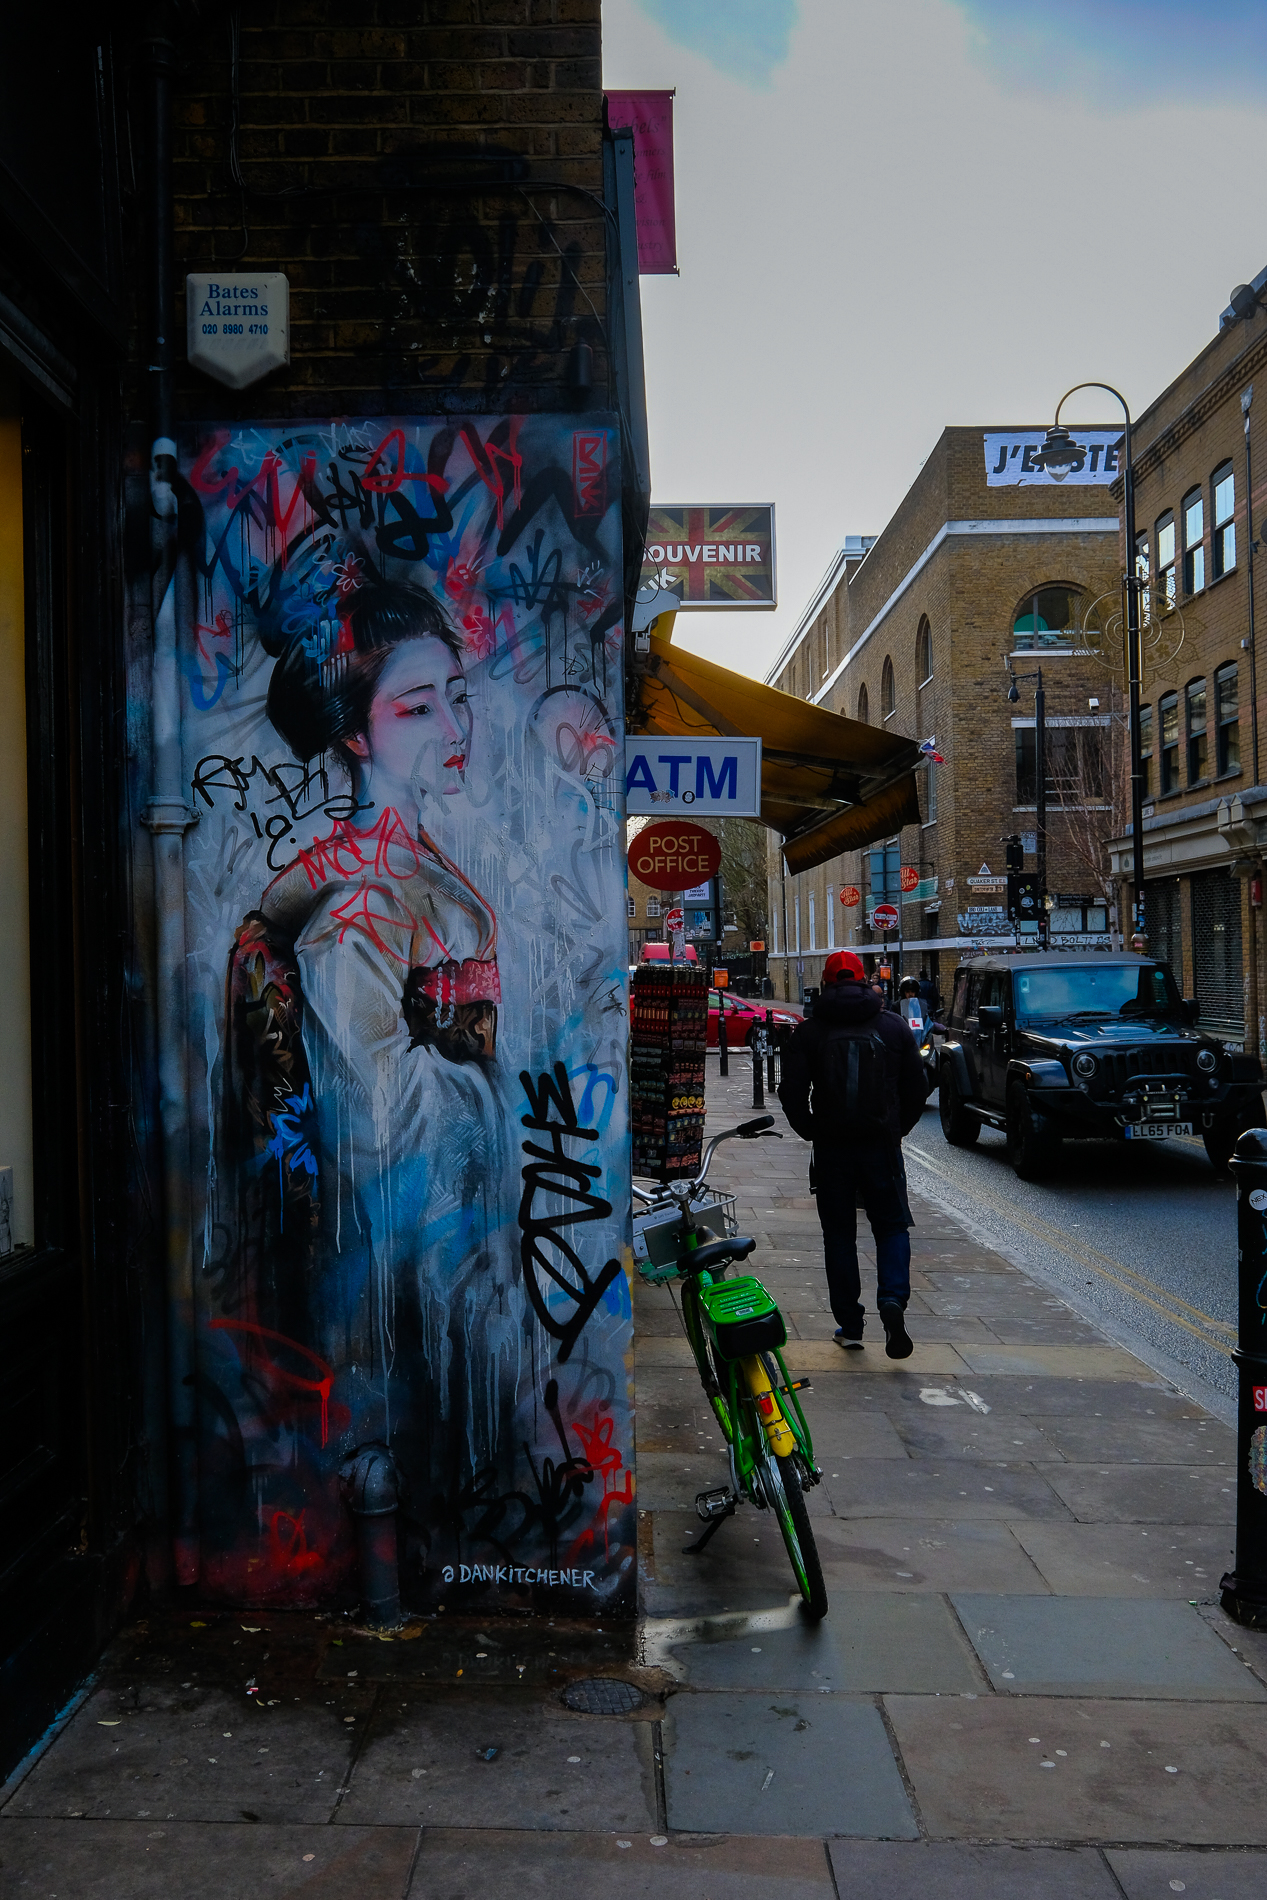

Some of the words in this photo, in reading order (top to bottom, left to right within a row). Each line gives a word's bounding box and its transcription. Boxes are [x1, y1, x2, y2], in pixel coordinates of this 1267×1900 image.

[207, 283, 259, 299] Bates
[199, 300, 269, 316] Alarms
[202, 323, 218, 335] 020
[222, 323, 244, 335] 8980
[248, 323, 269, 335] 4710
[992, 444, 1119, 474] J'ESTE
[626, 754, 738, 800] ATM
[649, 836, 702, 854] POST
[637, 854, 710, 874] OFFICE
[912, 1019, 920, 1027] L
[1133, 1125, 1164, 1137] LL65
